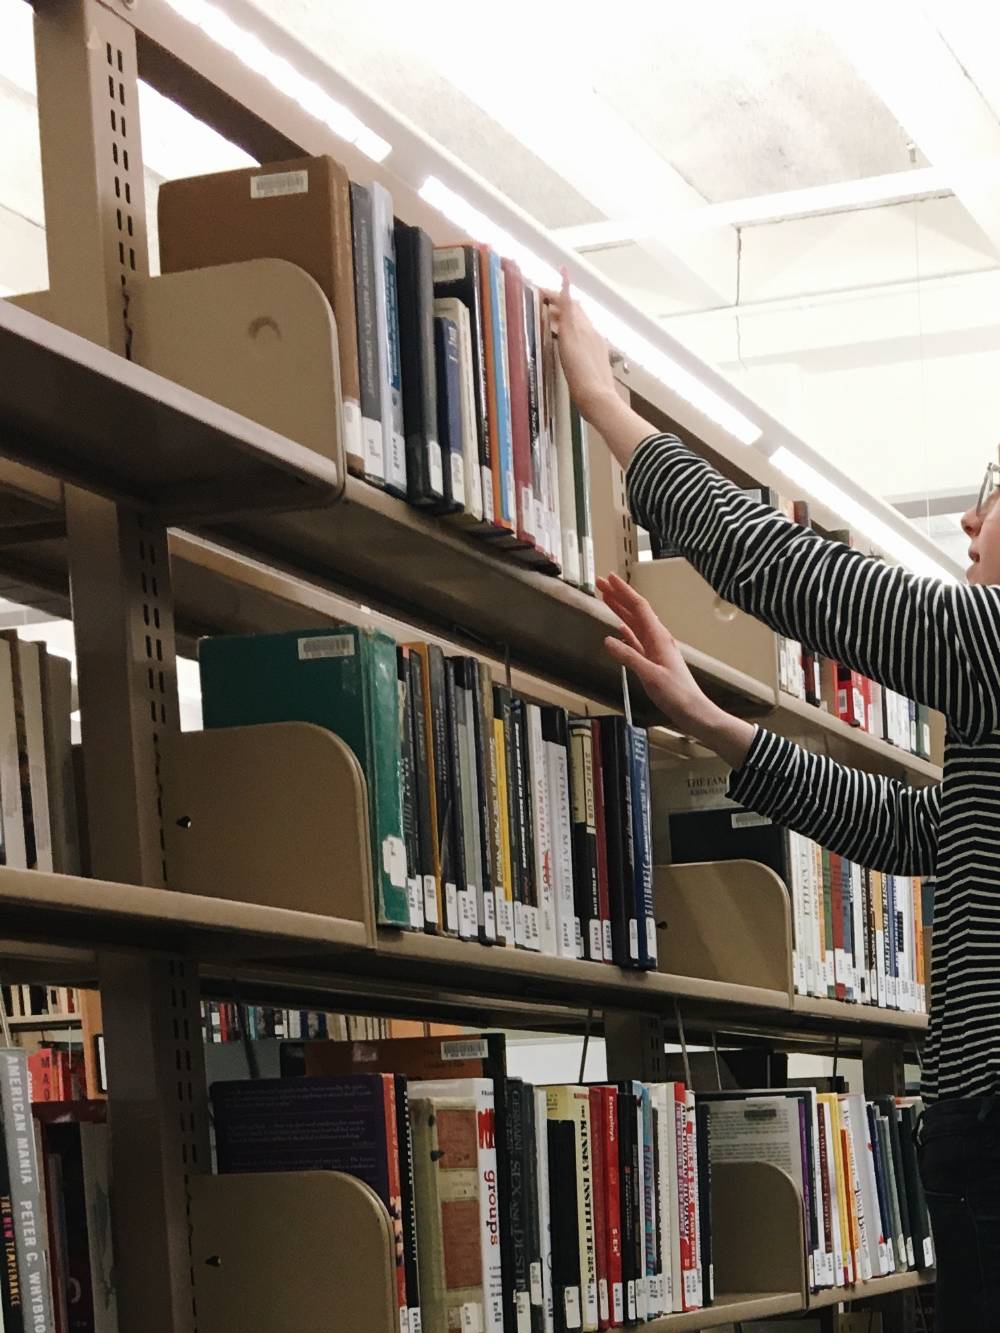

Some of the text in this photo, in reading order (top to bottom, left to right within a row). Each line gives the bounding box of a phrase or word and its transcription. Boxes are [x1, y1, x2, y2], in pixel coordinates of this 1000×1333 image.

[585, 752, 593, 784] STRIP
[538, 780, 551, 902] VIRGINITY LOST
[557, 756, 572, 901] INTIMATE MATTERS
[7, 1055, 27, 1130] AMERICAN
[17, 1138, 34, 1185] MANIA
[510, 1160, 522, 1198] SEX
[579, 1120, 591, 1174] KINSEY
[20, 1200, 38, 1246] PETER
[484, 1170, 501, 1246] groups
[583, 1178, 595, 1256] INSTITUTE
[1, 1195, 21, 1307] THE NEW TEMPERANCE
[27, 1252, 41, 1269] C.
[511, 1226, 526, 1291] DESTIN
